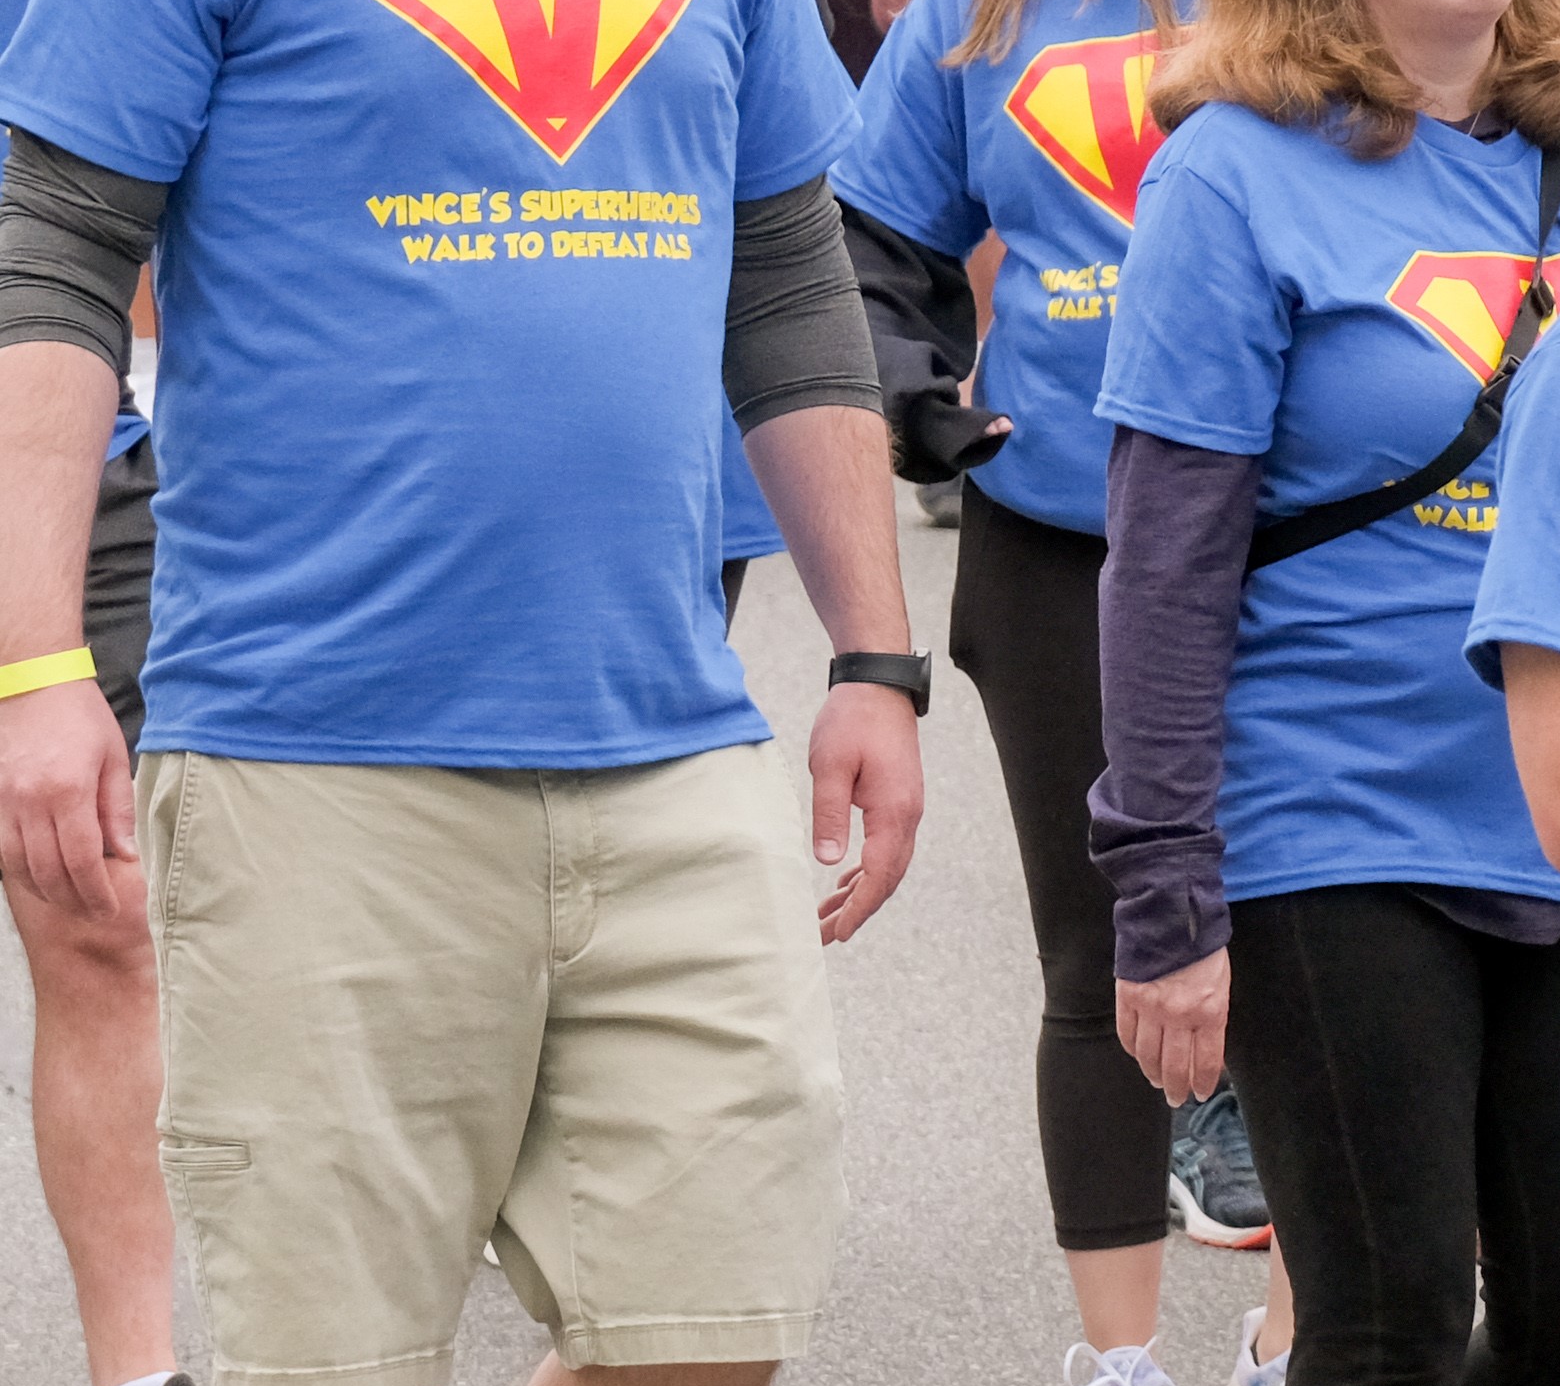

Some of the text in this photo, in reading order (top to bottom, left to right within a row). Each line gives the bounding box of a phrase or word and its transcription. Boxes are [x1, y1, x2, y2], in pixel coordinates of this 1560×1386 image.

[364, 187, 701, 228] VINCE'S SUPERHEROES
[401, 230, 692, 265] WALK TO DEFEAT ALS
